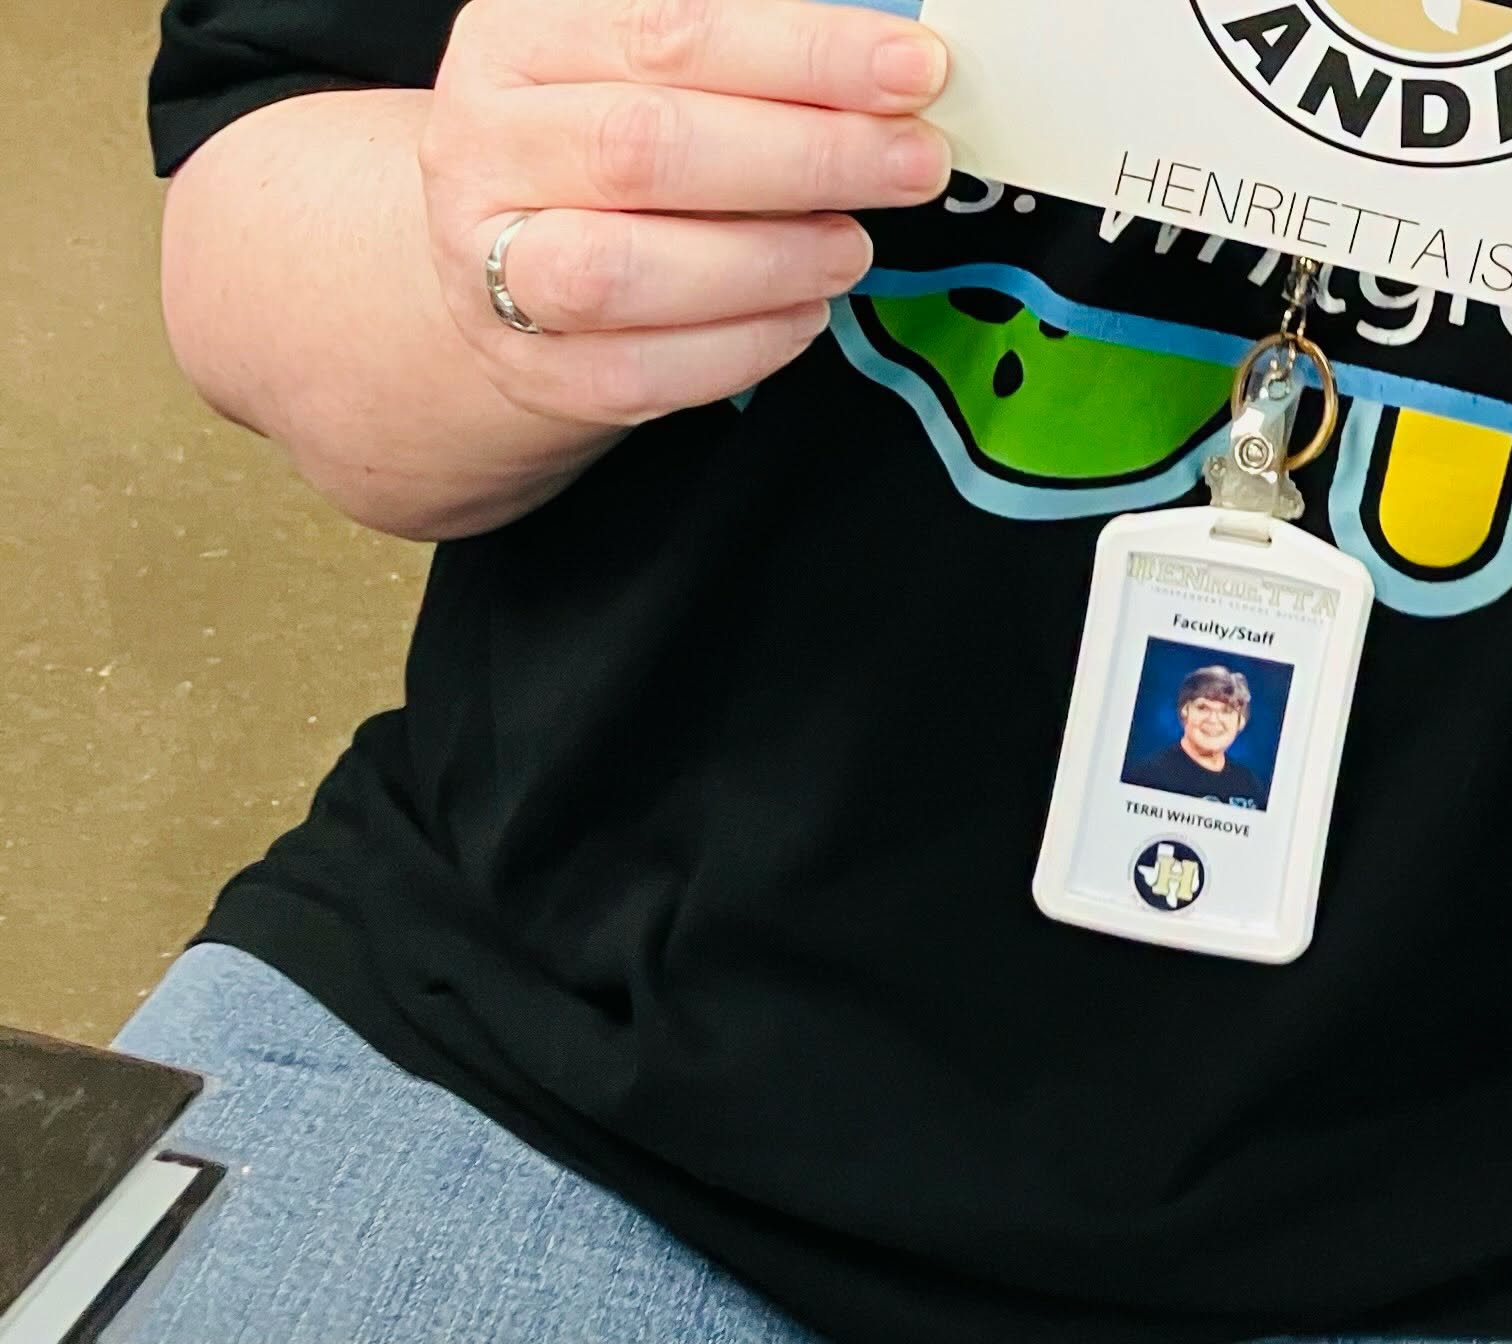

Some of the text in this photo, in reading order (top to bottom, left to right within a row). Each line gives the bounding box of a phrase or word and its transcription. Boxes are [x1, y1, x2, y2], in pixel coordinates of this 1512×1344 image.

[1114, 150, 1450, 279] HENRIETTA
[1172, 613, 1276, 646] Faculty/Staff
[1125, 799, 1250, 838] TERRI WHITGROVE
